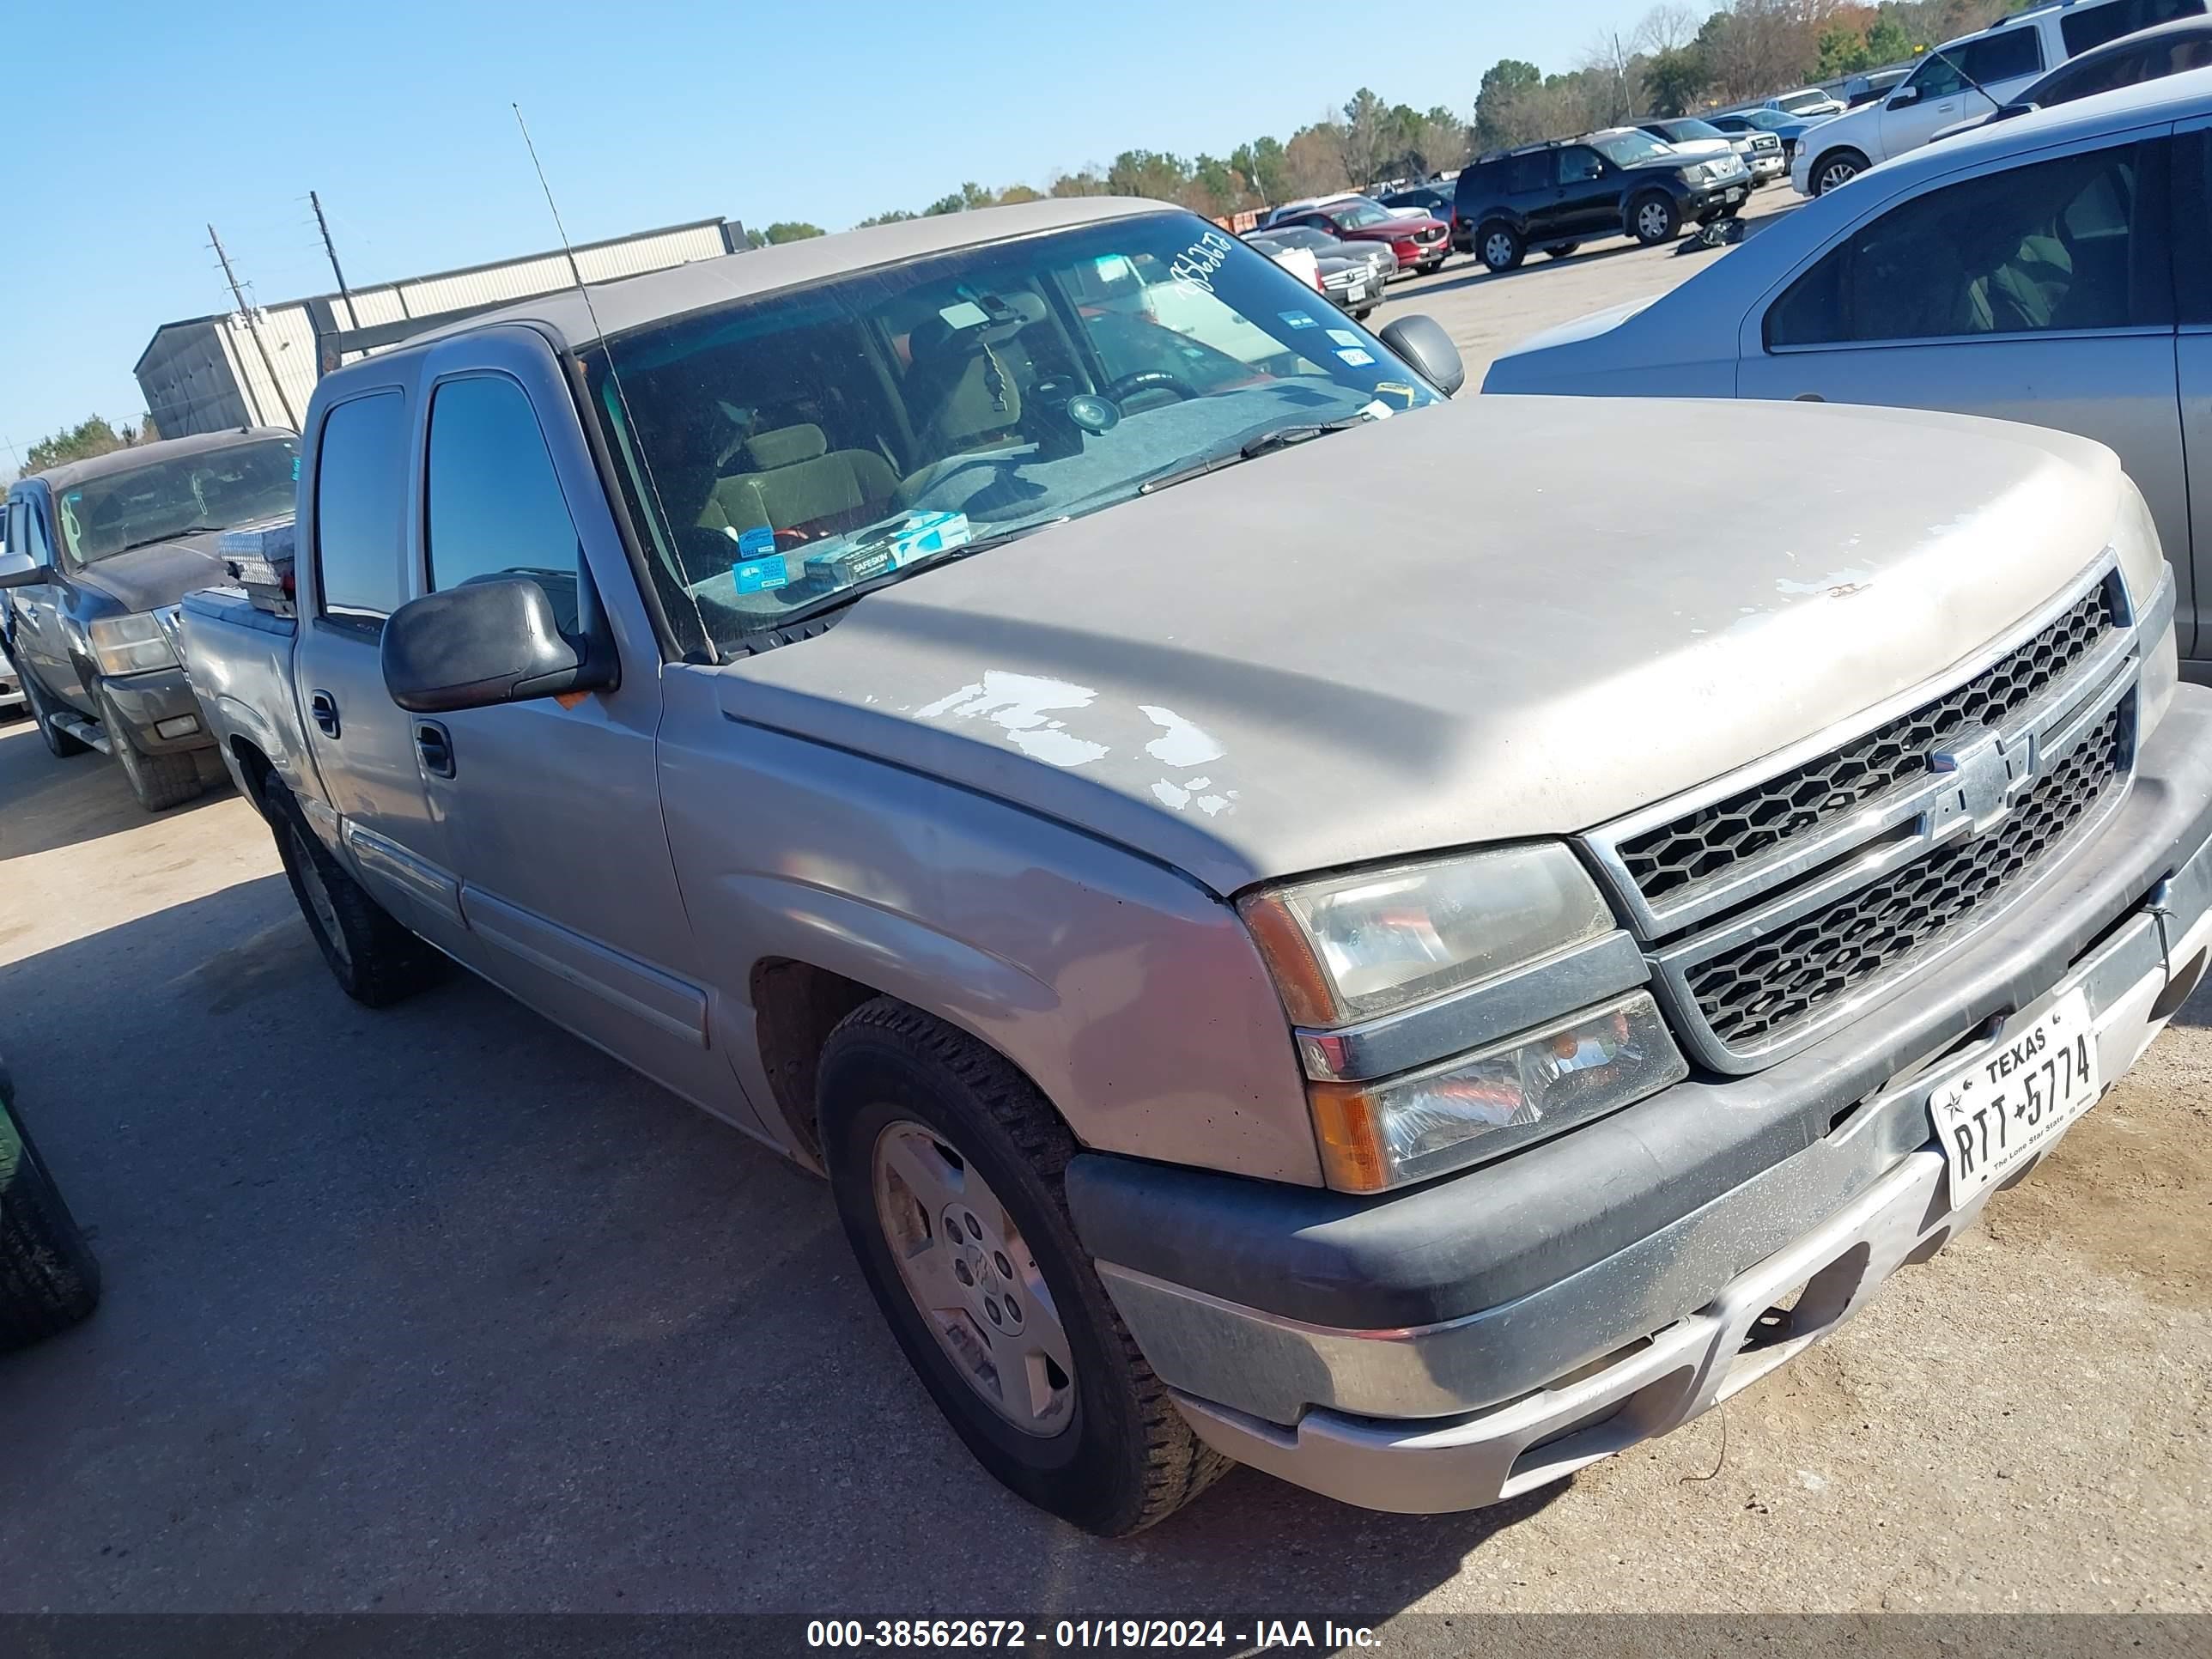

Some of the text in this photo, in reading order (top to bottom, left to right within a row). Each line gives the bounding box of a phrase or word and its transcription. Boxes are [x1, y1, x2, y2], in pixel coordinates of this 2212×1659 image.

[853, 553, 889, 573] SAFESKIN
[1985, 1027, 2046, 1084] TEXAS
[1954, 1033, 2089, 1181] RTT 5774
[1993, 1114, 2065, 1171] The Lone Star State
